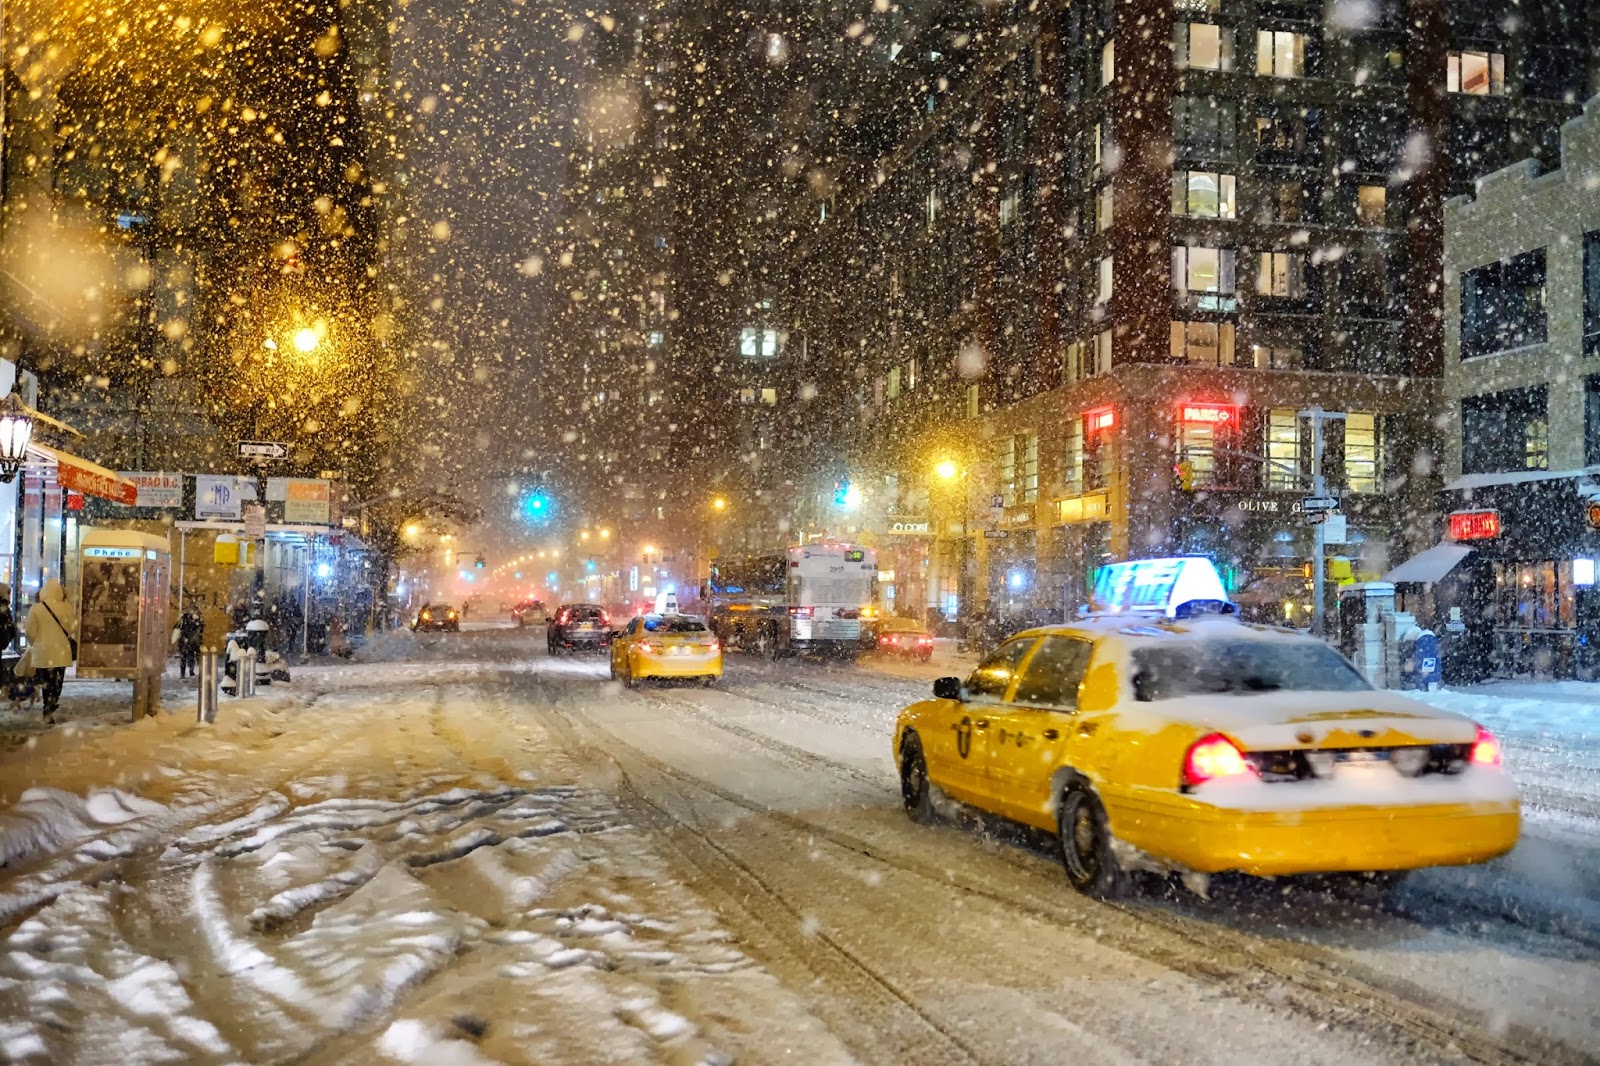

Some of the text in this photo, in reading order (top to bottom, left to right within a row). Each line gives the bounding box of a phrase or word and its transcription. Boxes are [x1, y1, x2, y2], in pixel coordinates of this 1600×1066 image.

[1184, 408, 1219, 422] PARK
[1238, 500, 1279, 512] OLIVE
[94, 548, 131, 557] Phone
